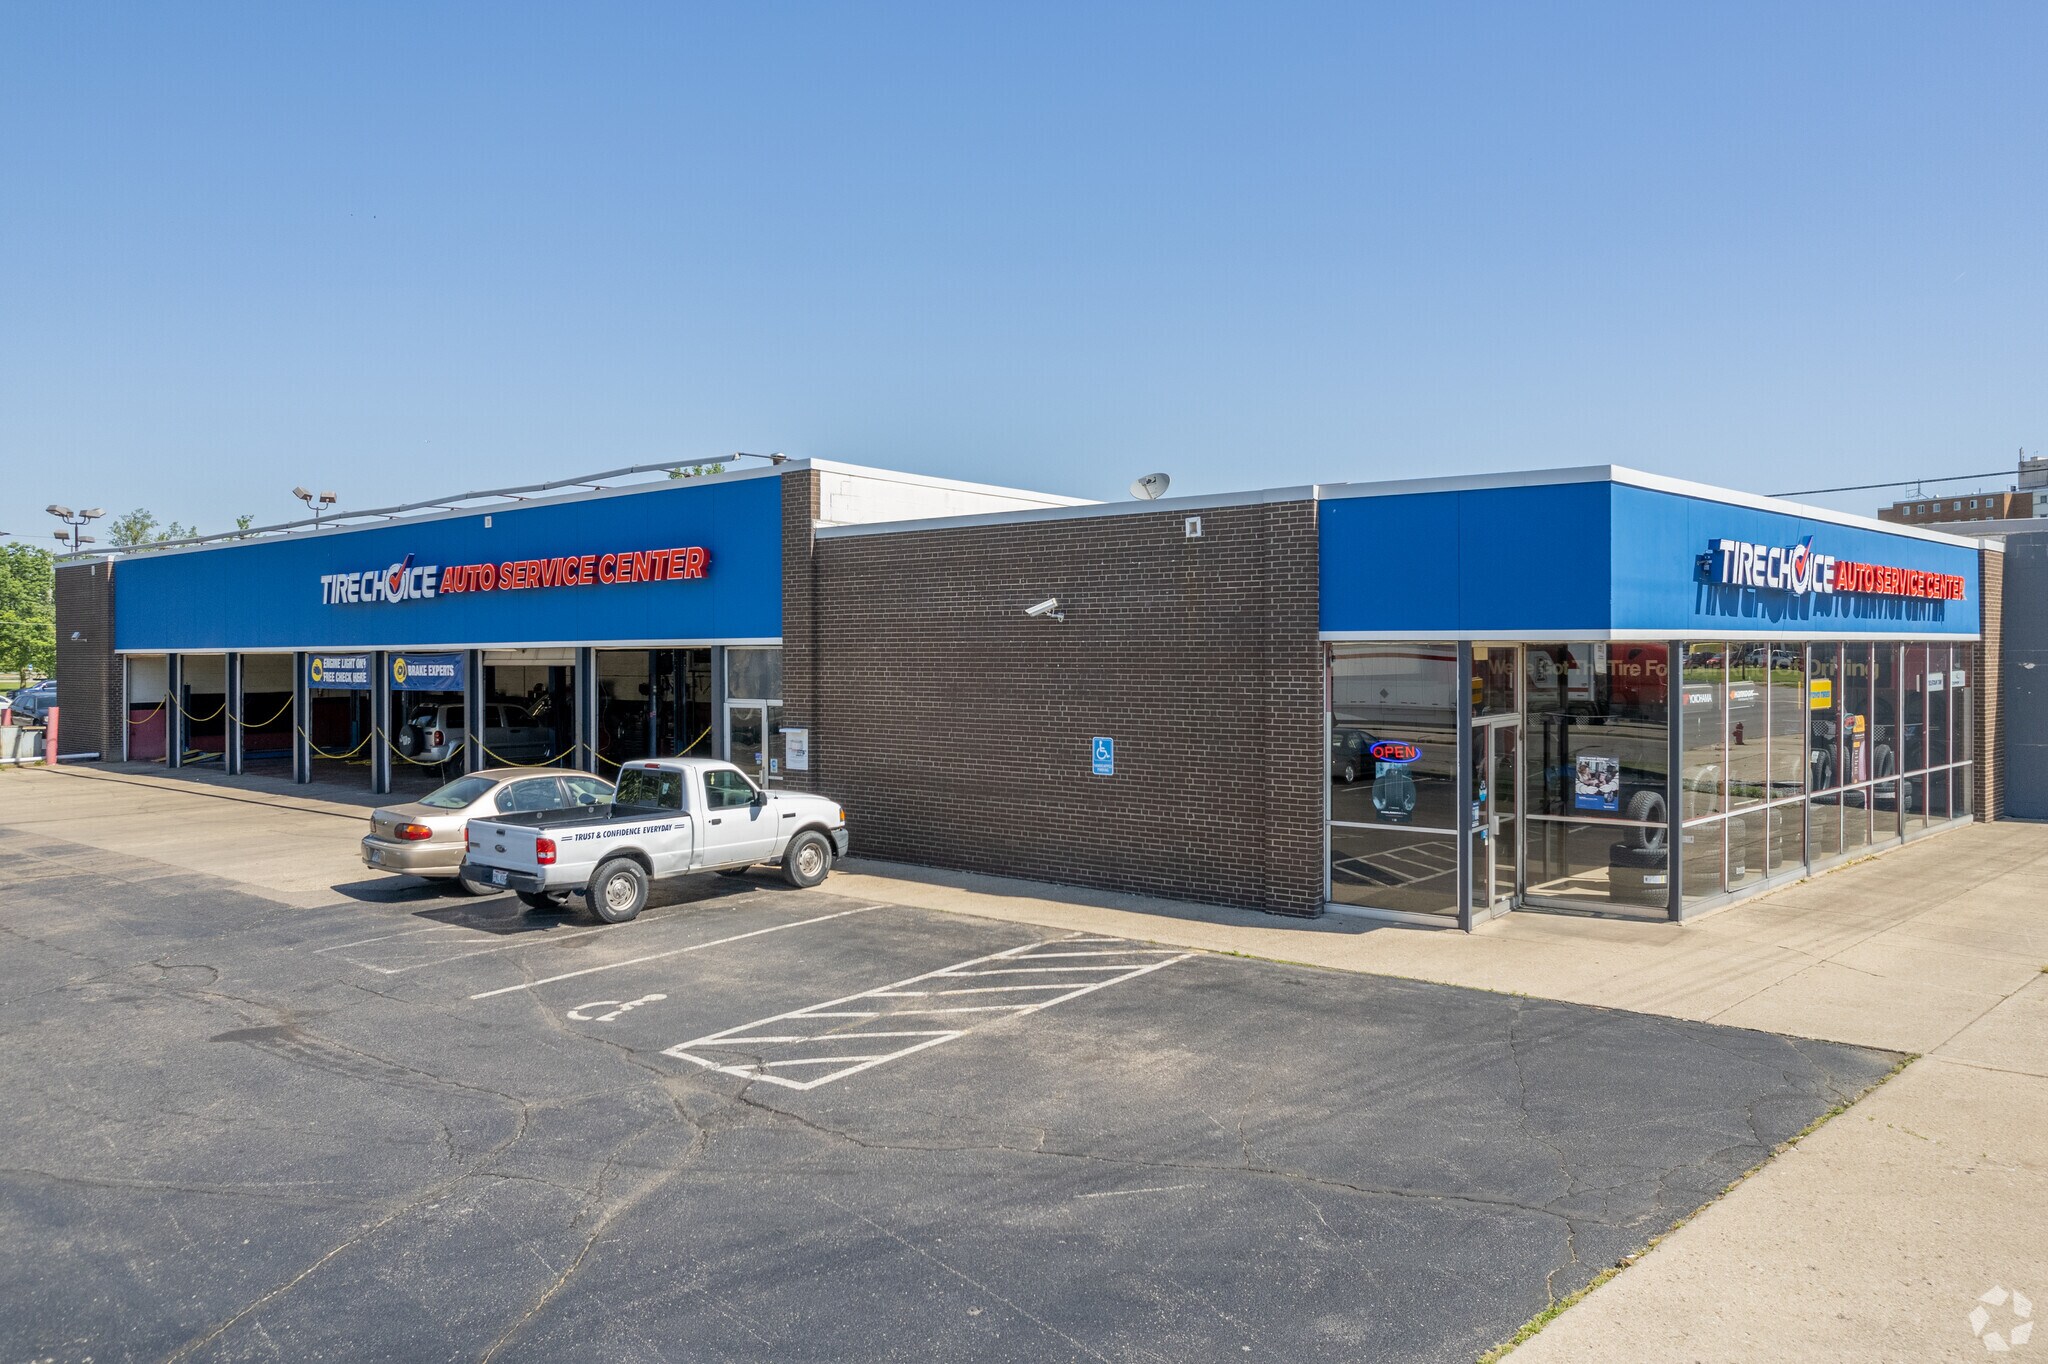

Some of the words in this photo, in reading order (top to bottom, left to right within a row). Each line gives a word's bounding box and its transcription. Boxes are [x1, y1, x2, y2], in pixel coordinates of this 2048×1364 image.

[439, 563, 496, 594] AUTO
[498, 554, 596, 590] SERVICE
[600, 546, 705, 584] CENTER
[1836, 561, 1874, 591] AUTO
[1876, 565, 1925, 598] SERVICE
[1926, 571, 1967, 601] CENTER
[323, 657, 341, 669] ENGINE
[341, 657, 355, 669] LIGHT
[1545, 659, 1569, 676] Got
[1607, 659, 1642, 677] Tire
[323, 671, 335, 682] FREE
[336, 671, 352, 682] CHECK
[353, 671, 367, 683] HERE
[408, 664, 427, 677] BRAKE
[428, 664, 454, 677] EXPERTS
[1689, 693, 1712, 704] YOKOHAMA
[1373, 746, 1416, 759] OPEN
[575, 832, 595, 841] TRUST
[596, 831, 602, 839] &
[603, 827, 641, 838] CONFIDENCE
[643, 823, 673, 834] EVERYDAY
